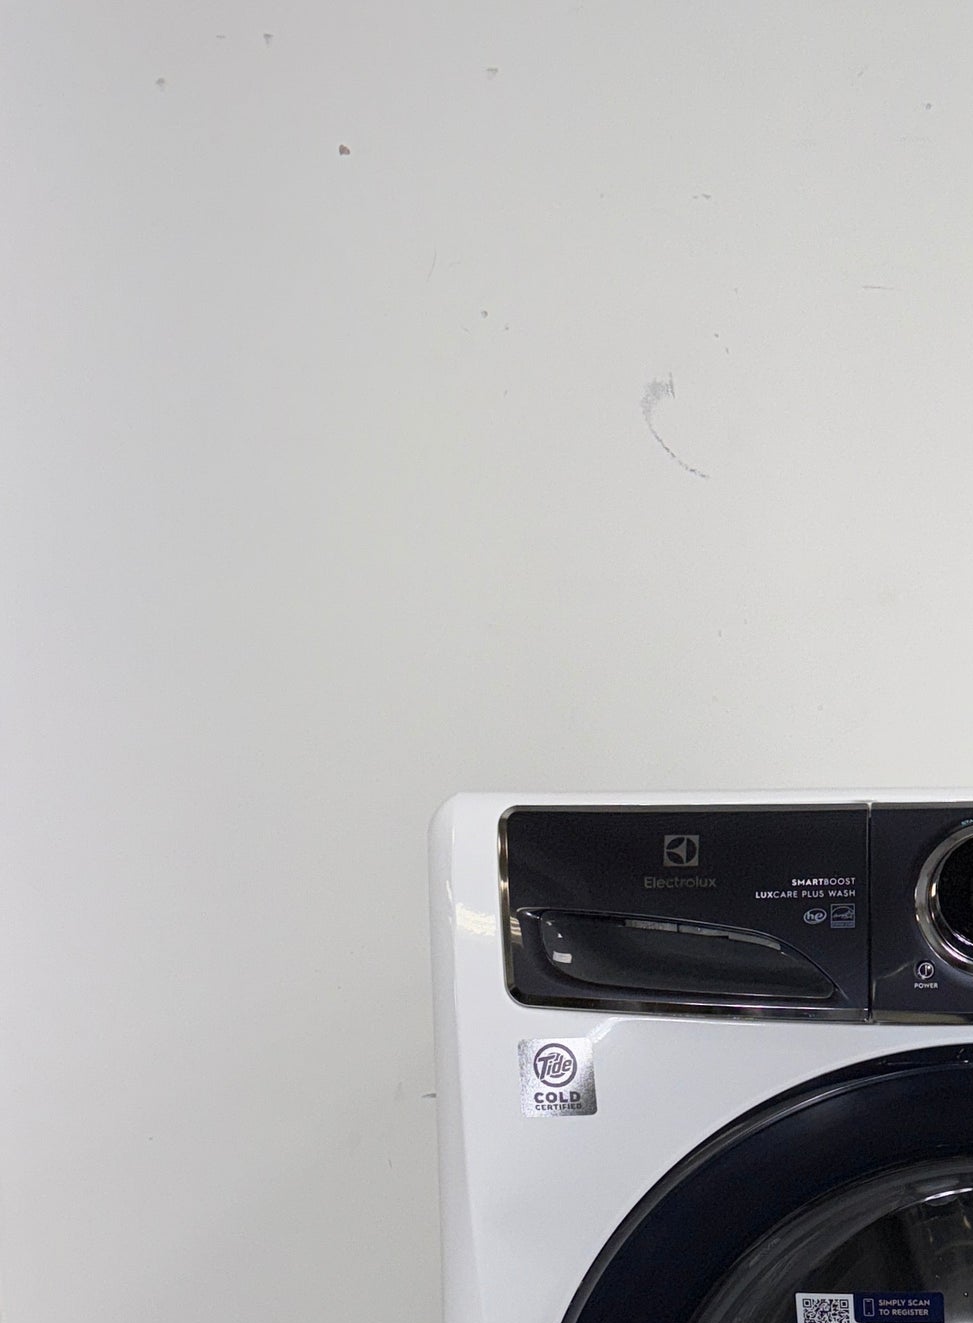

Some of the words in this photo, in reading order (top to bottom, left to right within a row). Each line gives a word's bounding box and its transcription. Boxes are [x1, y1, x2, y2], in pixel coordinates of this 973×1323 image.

[644, 876, 717, 890] Electrolux
[791, 877, 856, 887] SMARTBOOST
[755, 890, 799, 899] LUXCARE
[801, 889, 825, 898] PLUS
[828, 889, 856, 898] WASH
[538, 1052, 573, 1080] Tide
[534, 1091, 581, 1104] COLD
[535, 1103, 583, 1111] CERTIFIED
[878, 1299, 906, 1307] SIMPLY
[908, 1299, 931, 1307] SCAN
